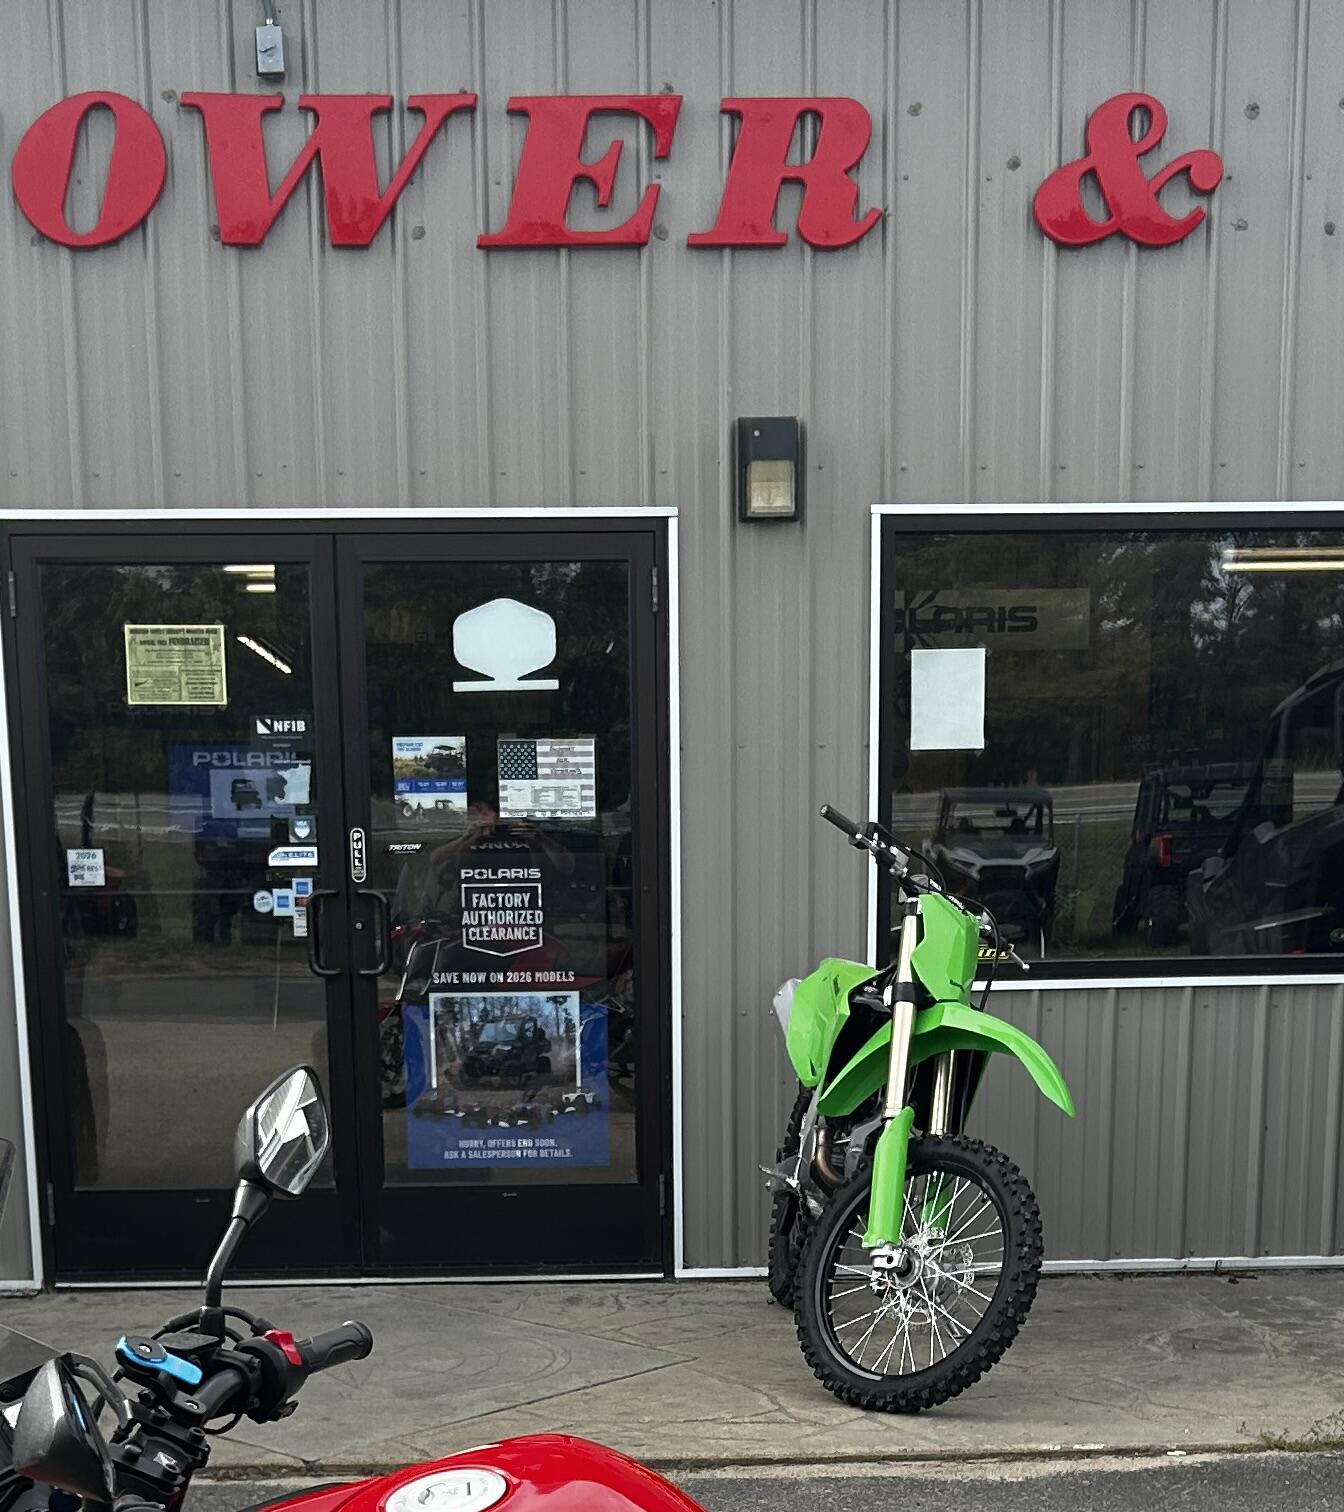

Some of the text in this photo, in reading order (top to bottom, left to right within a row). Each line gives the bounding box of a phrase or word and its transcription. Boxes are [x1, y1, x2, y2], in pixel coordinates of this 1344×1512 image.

[1033, 91, 1224, 248] &
[273, 720, 306, 732] NFIB
[193, 752, 297, 767] POLARI
[353, 833, 362, 866] PULL
[389, 843, 421, 851] TRITON
[461, 869, 541, 879] POLARIS
[472, 893, 531, 908] FACTORY
[462, 910, 543, 925] AUTHORIZED
[469, 926, 537, 941] CLEARANCE
[432, 971, 575, 983] SAVE NOW ON 2026 MODELS
[459, 1139, 558, 1150] HURRY, OFFERS END SOON.
[444, 1149, 574, 1160] ASK A SALESPERSON FOR DETAILS.
